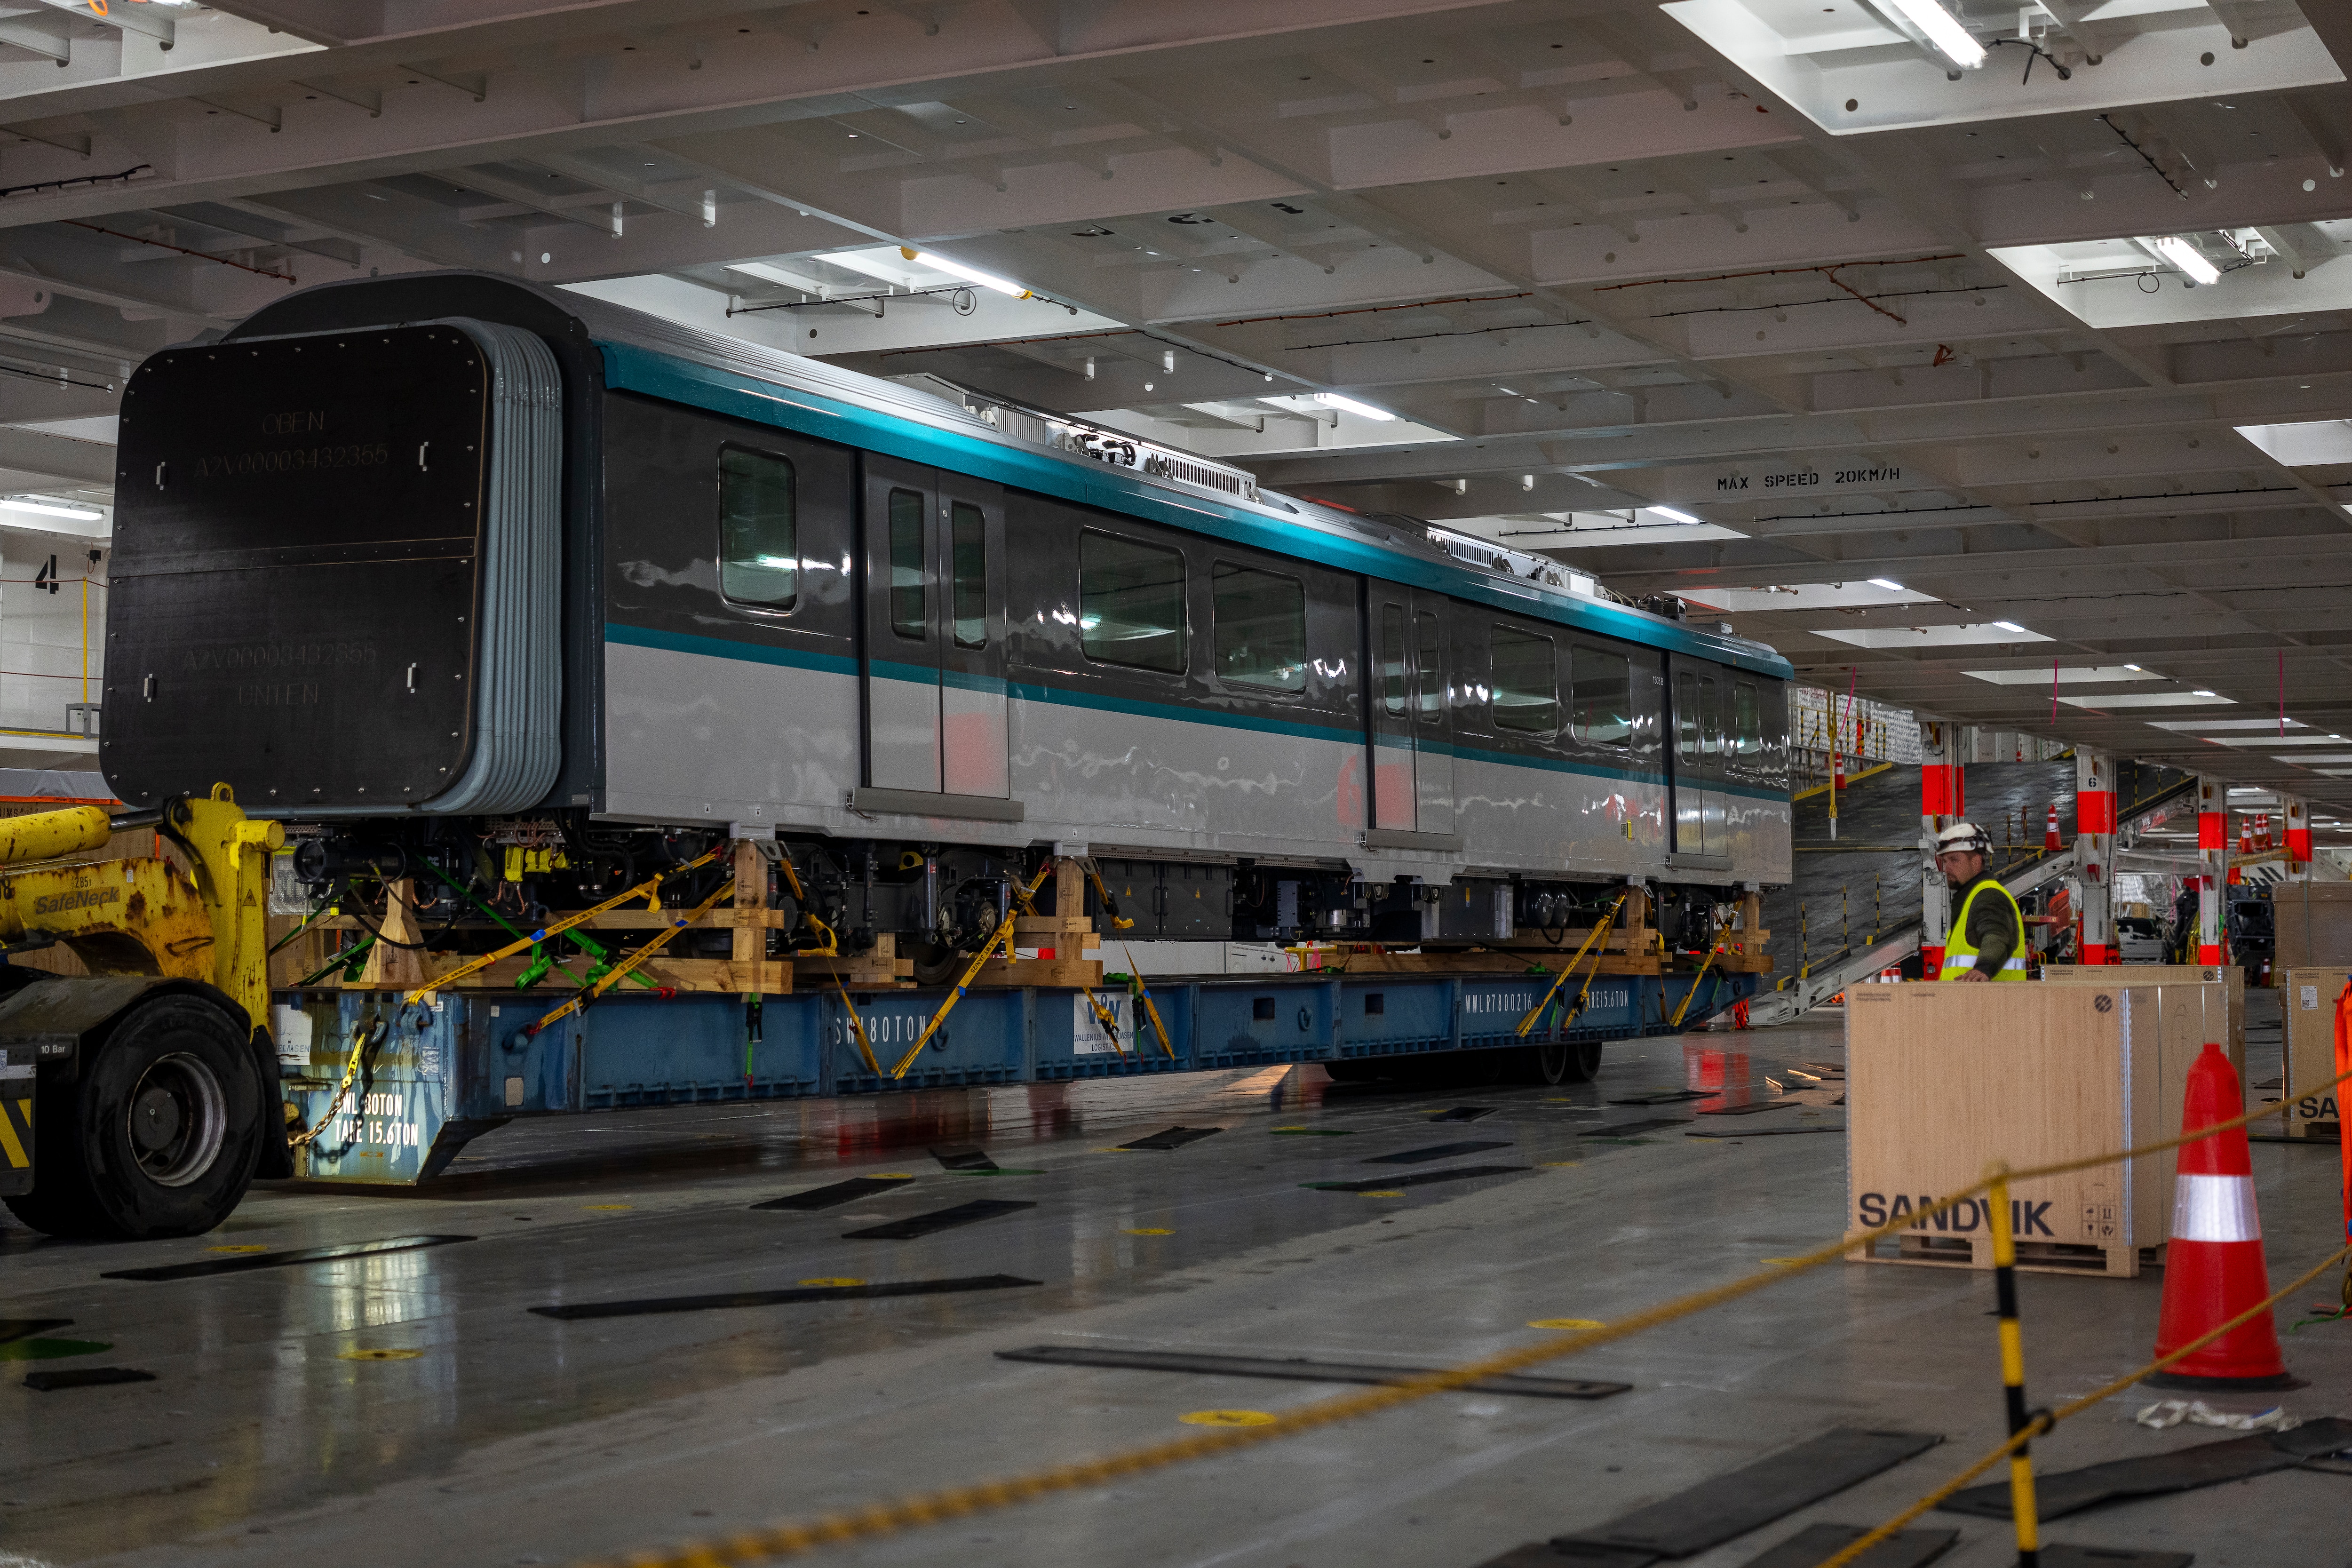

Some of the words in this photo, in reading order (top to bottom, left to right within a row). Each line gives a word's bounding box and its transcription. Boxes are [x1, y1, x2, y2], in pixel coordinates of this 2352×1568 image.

[262, 410, 324, 435] OBEN
[194, 443, 389, 478] A2V00003432355
[1717, 477, 1749, 490] MAX
[1765, 473, 1819, 487] SPEED
[1835, 467, 1900, 484] 20KM/H
[35, 555, 59, 595] 4
[238, 682, 319, 706] UNTEN
[2089, 777, 2097, 788] 6
[35, 886, 119, 915] SafeNeck
[985, 946, 992, 955] MT
[970, 955, 985, 973] JAN/25
[1466, 993, 1532, 1013] WWLR7800216
[1074, 1034, 1101, 1042] WALLENIUS
[1103, 1031, 1133, 1040] WILEMSEN
[41, 1045, 49, 1054] 10
[52, 1045, 65, 1053] Bar
[369, 1121, 418, 1146] 15.6TON
